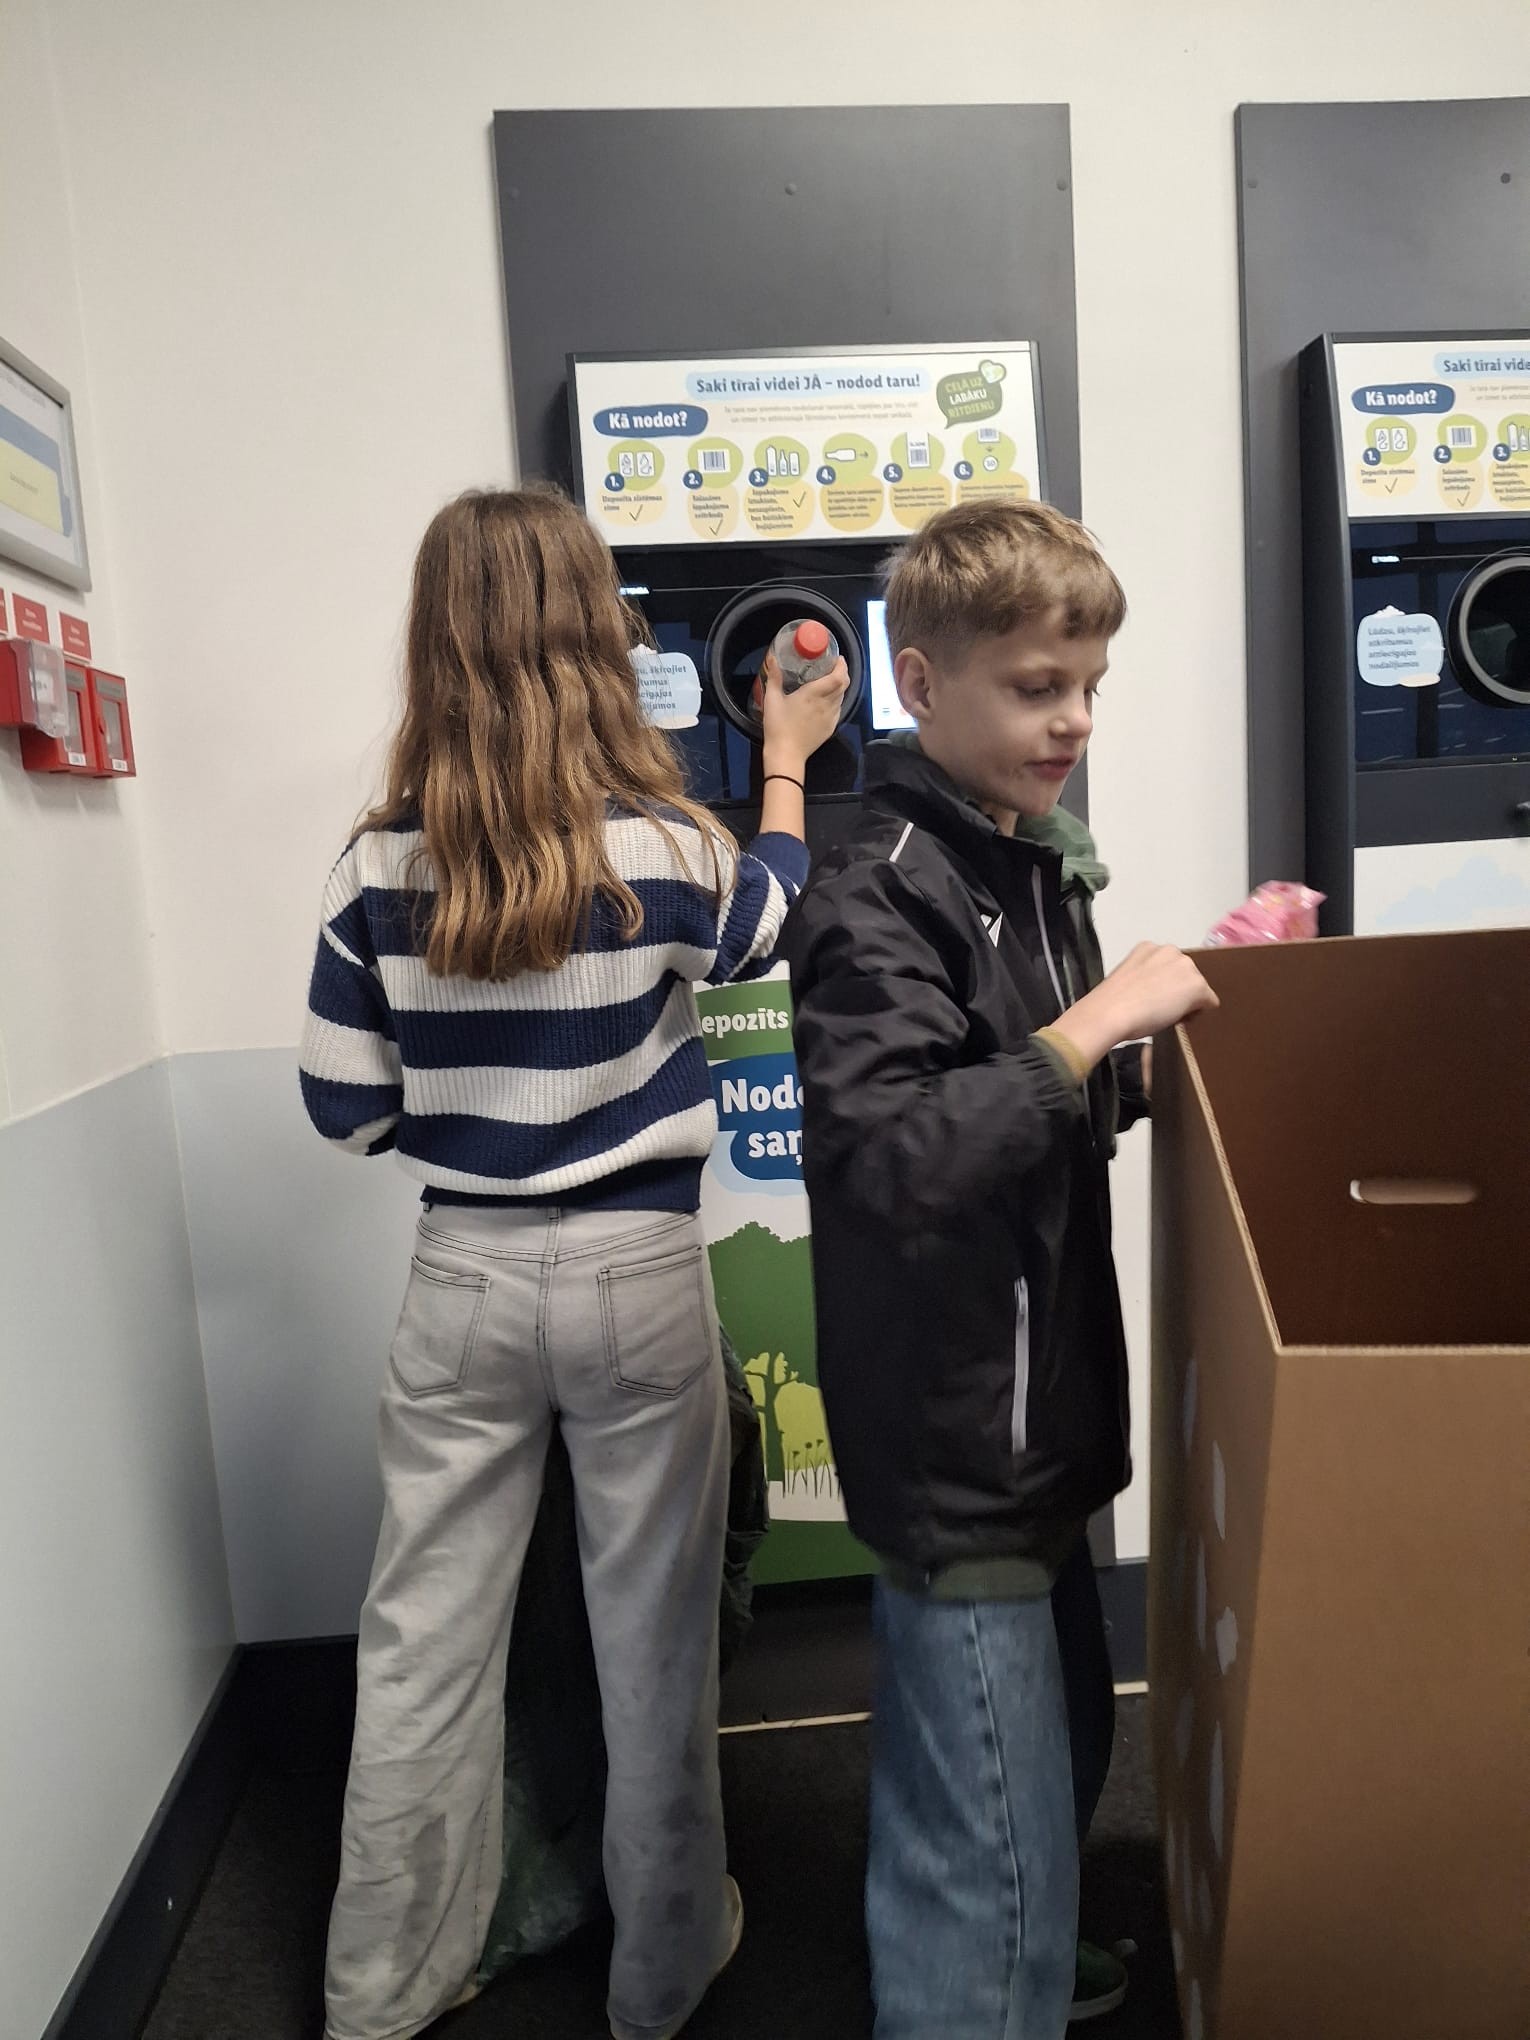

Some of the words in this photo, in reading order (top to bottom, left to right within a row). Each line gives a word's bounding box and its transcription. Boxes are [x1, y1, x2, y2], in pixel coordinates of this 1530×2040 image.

[1443, 358, 1471, 373] Saki
[1474, 358, 1501, 372] tīrai
[696, 377, 727, 393] Saki
[731, 376, 761, 392] tīrai
[764, 376, 801, 391] videi
[803, 374, 822, 390] JĀ
[837, 374, 883, 389] nodod
[886, 373, 920, 388] taru!
[1365, 390, 1385, 406] Kā
[1387, 389, 1437, 405] nodot?
[609, 412, 630, 429] Kā
[633, 411, 688, 428] nodot?
[754, 470, 764, 483] 3.
[822, 468, 833, 481] 4.
[888, 466, 898, 478] 5.
[959, 464, 970, 476] 6.
[609, 475, 620, 487] 1.
[688, 472, 699, 485] 2.
[698, 1007, 789, 1039] epozīts
